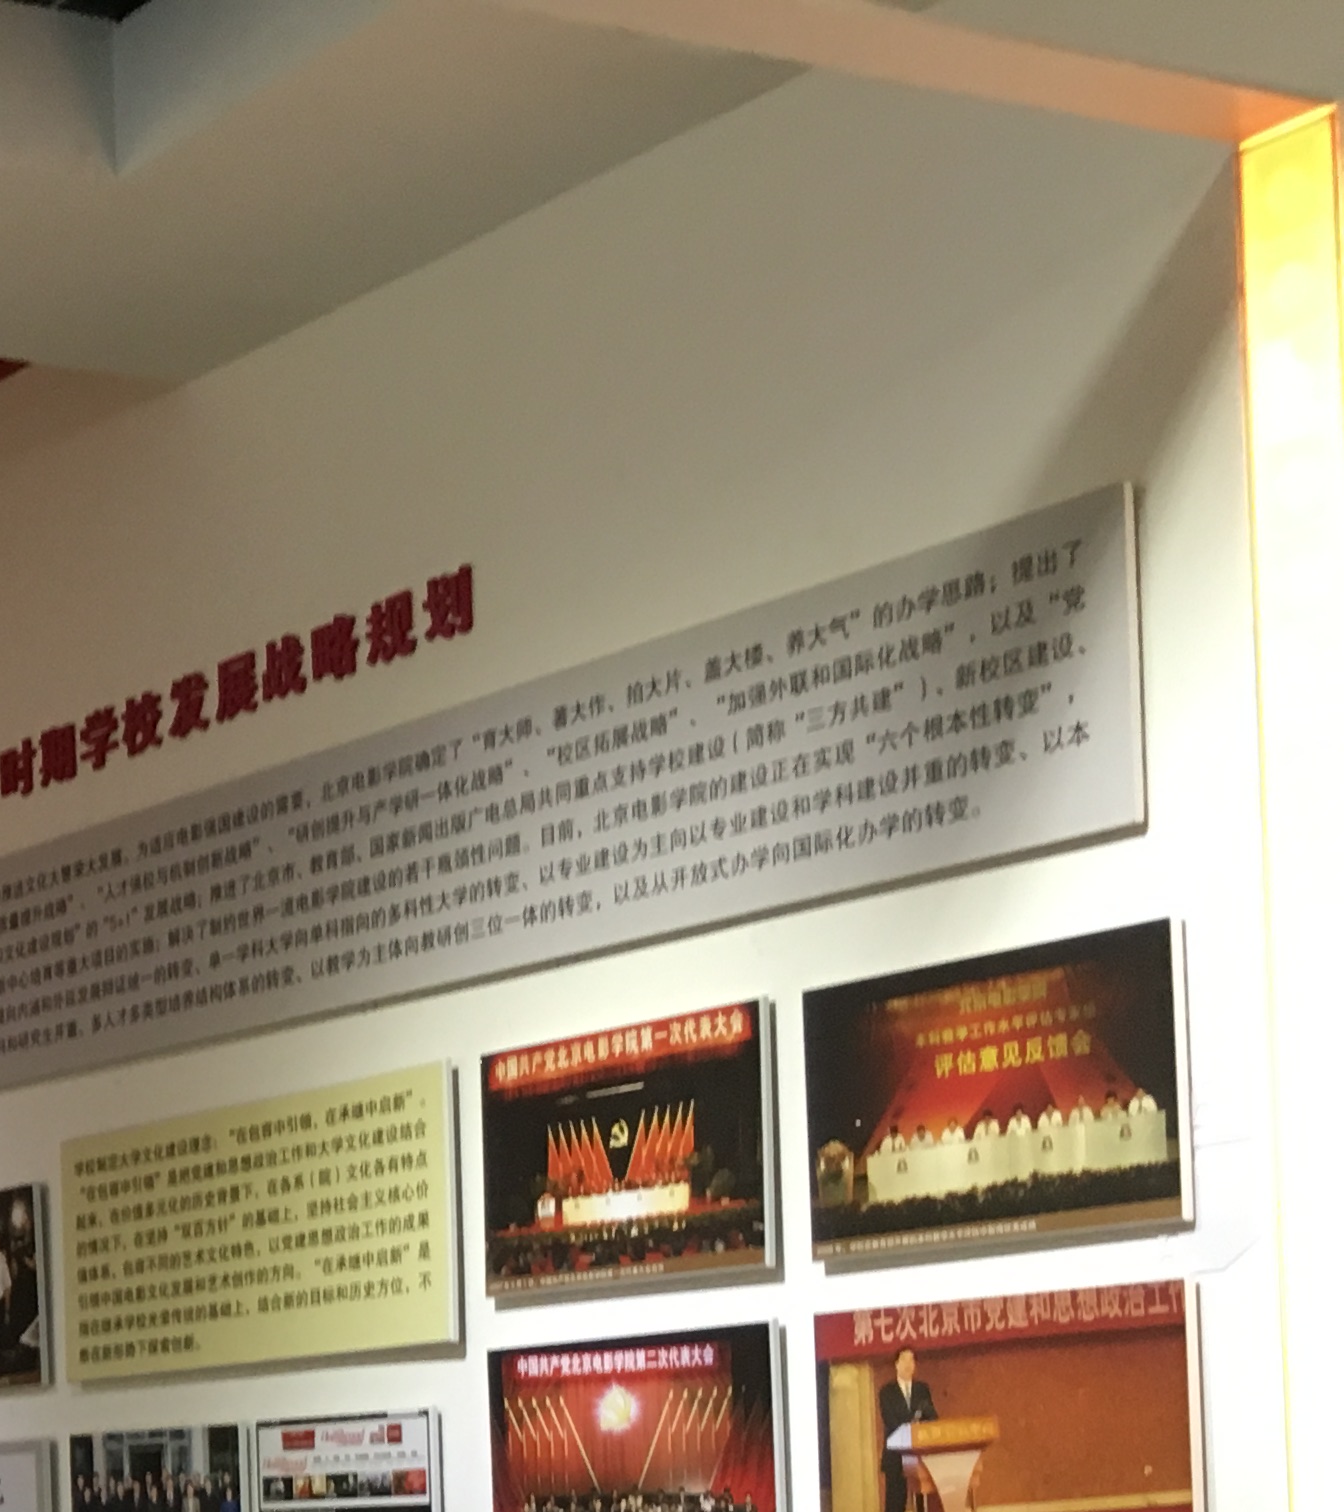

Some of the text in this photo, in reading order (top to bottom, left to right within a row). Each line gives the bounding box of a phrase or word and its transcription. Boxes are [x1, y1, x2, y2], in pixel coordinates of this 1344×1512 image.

[495, 1008, 744, 1083] 中国共产党北京电影学院第一次代表大会
[934, 1028, 1093, 1080] 评估意见反馈会
[517, 1341, 715, 1378] 中国共产党北京电影学院第二次代表大会
